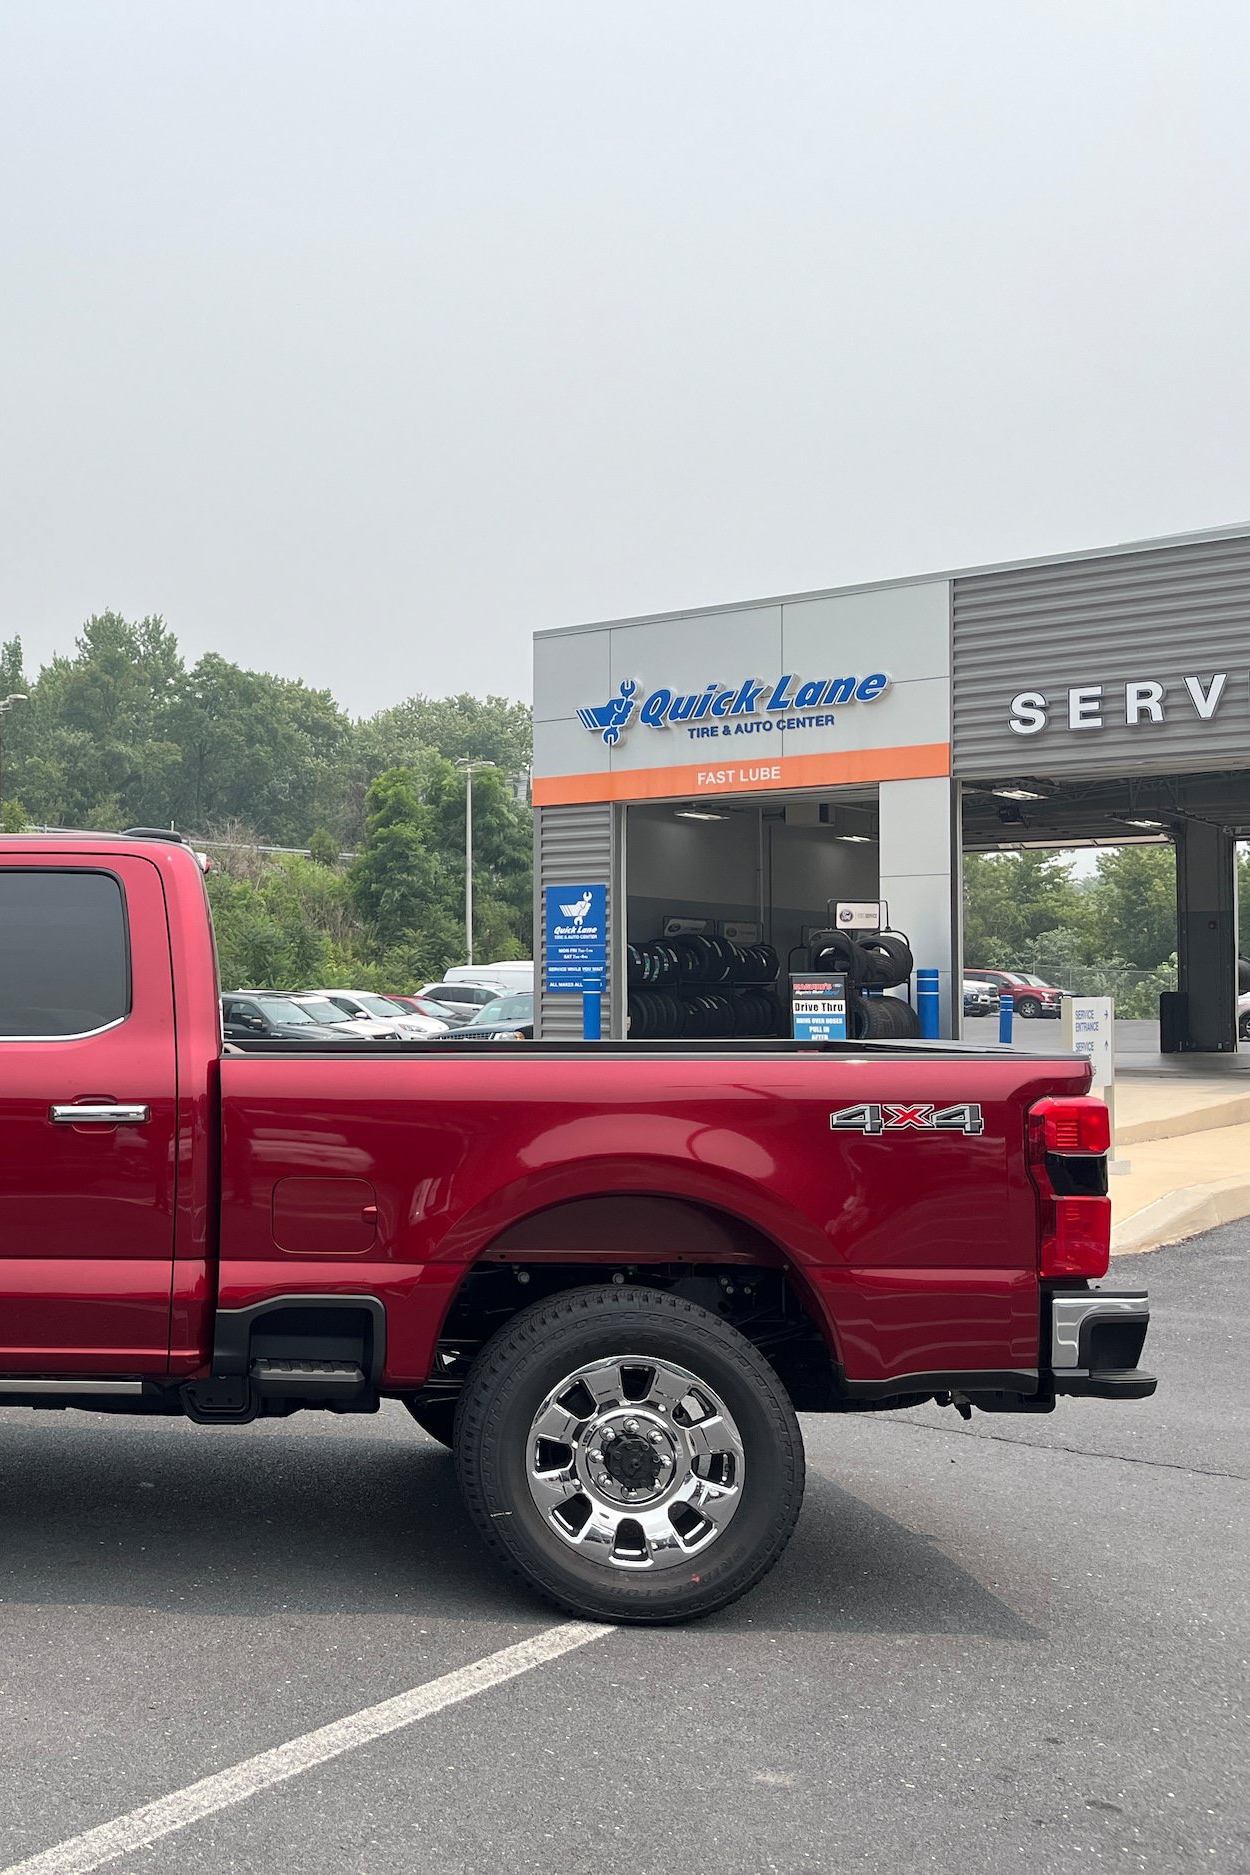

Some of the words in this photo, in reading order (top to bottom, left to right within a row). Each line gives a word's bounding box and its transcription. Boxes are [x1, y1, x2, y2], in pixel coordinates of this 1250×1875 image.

[639, 679, 763, 728] Quick
[766, 673, 888, 712] Lane
[1008, 673, 1228, 735] SERV
[687, 726, 718, 739] TIRE
[722, 725, 732, 736] &
[734, 720, 774, 735] AUTO
[777, 714, 835, 731] CENTER
[697, 769, 733, 785] FAST
[740, 766, 781, 782] LUBE
[554, 926, 576, 935] Quick
[795, 1002, 819, 1012] Drive
[821, 1002, 843, 1012] Thru
[1075, 1009, 1094, 1019] SERVICE
[1075, 1021, 1099, 1032] ENTRANCE
[1075, 1041, 1094, 1052] SERVICE
